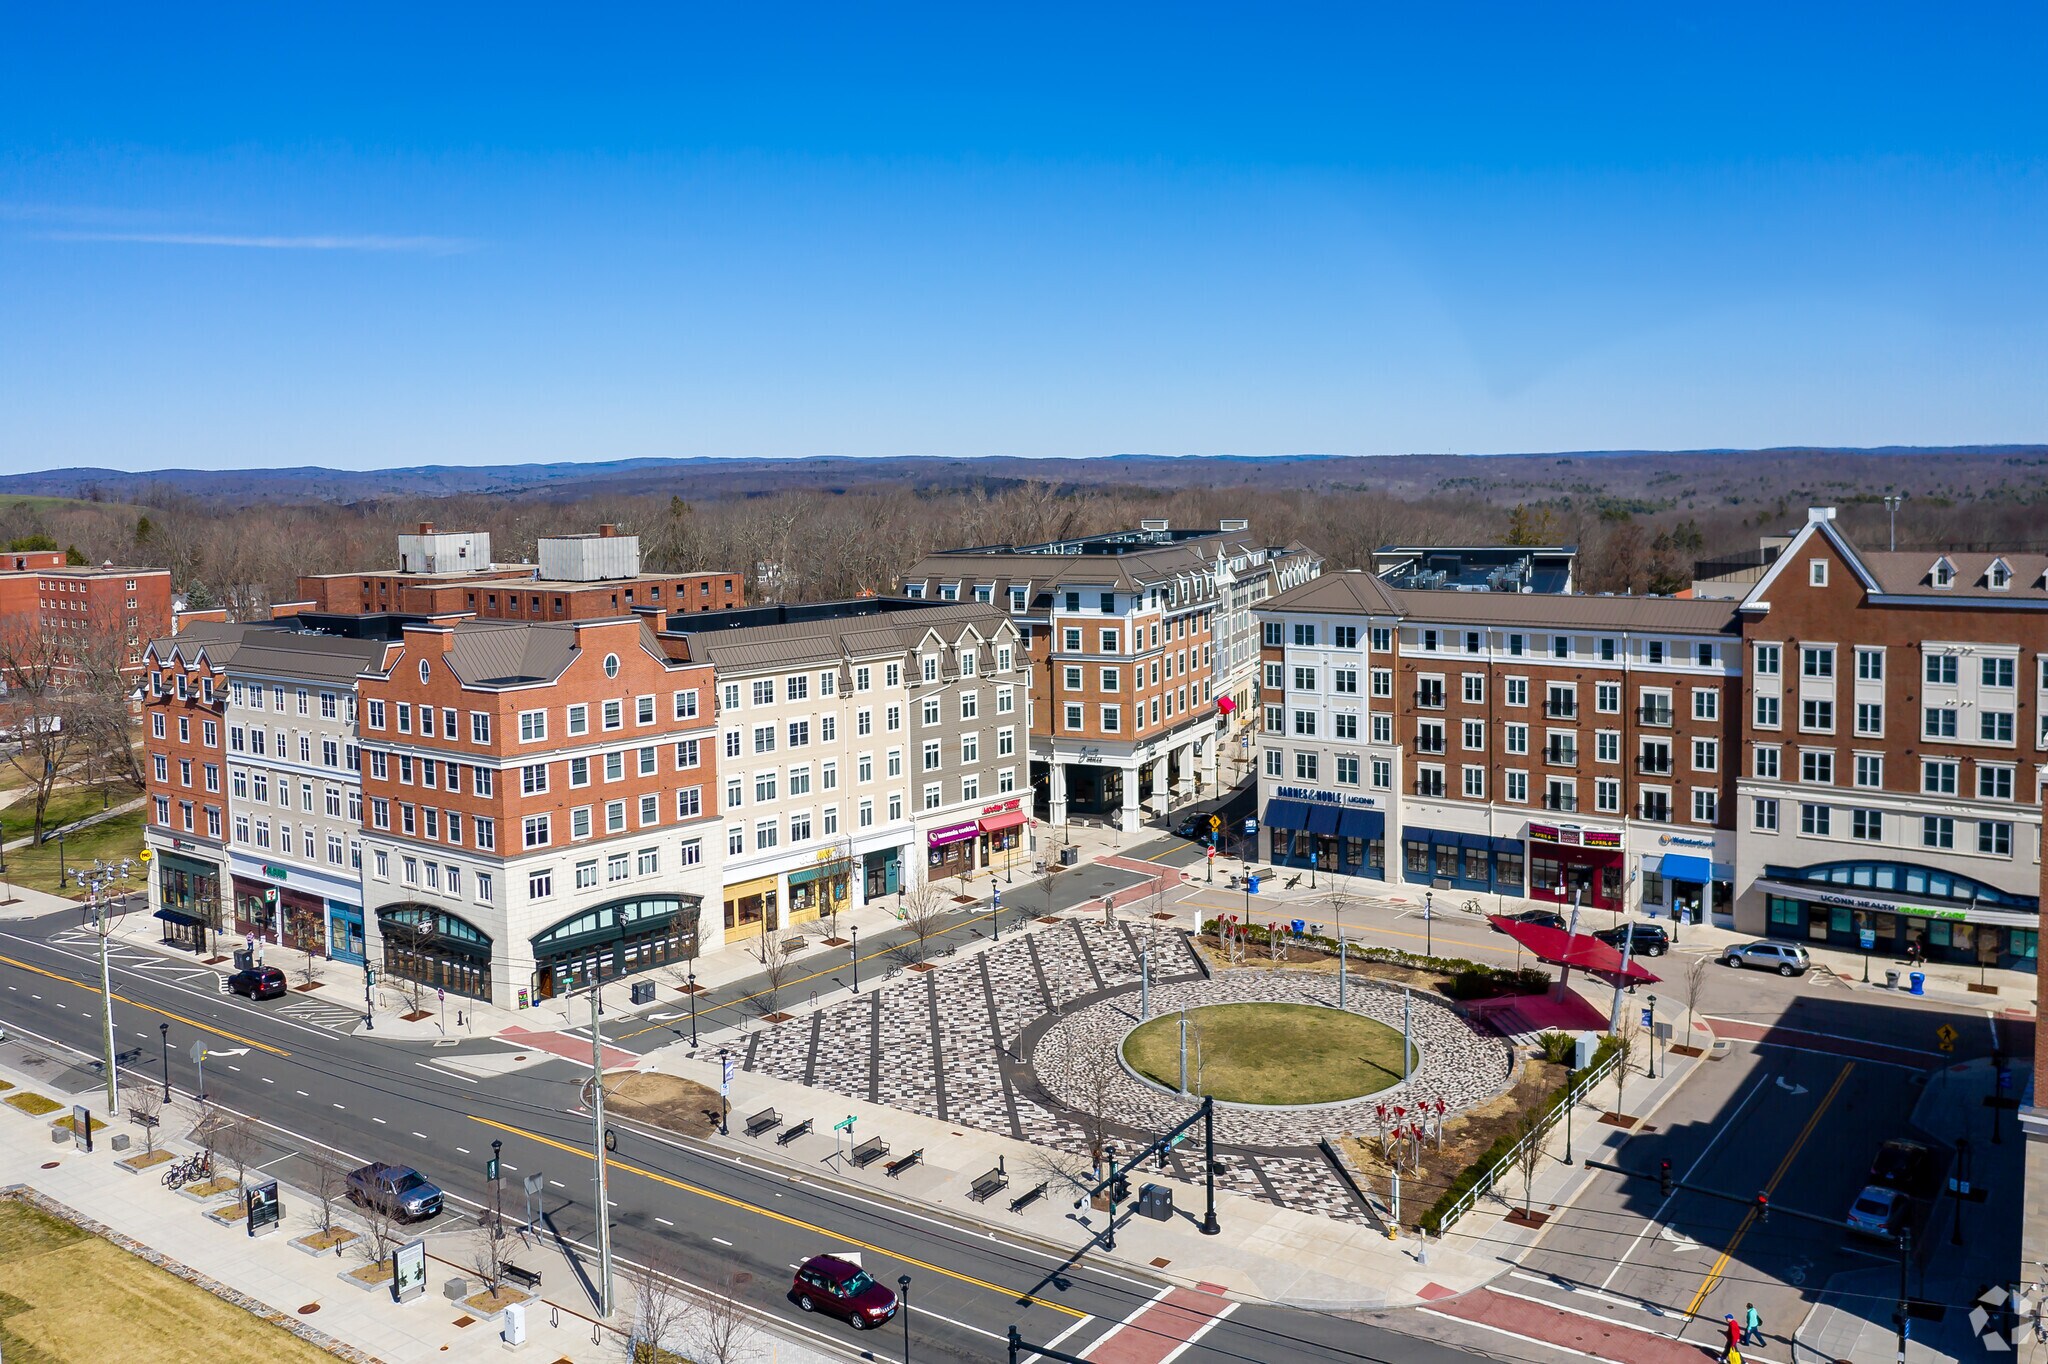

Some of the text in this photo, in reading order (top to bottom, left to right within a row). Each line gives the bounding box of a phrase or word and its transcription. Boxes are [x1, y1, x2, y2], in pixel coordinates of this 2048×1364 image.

[1277, 785, 1308, 800] BARNES
[1316, 790, 1342, 804] NOBLE
[1348, 796, 1375, 805] UCONN
[1820, 895, 1855, 907] UCONN
[1856, 899, 1895, 911] HEALTH
